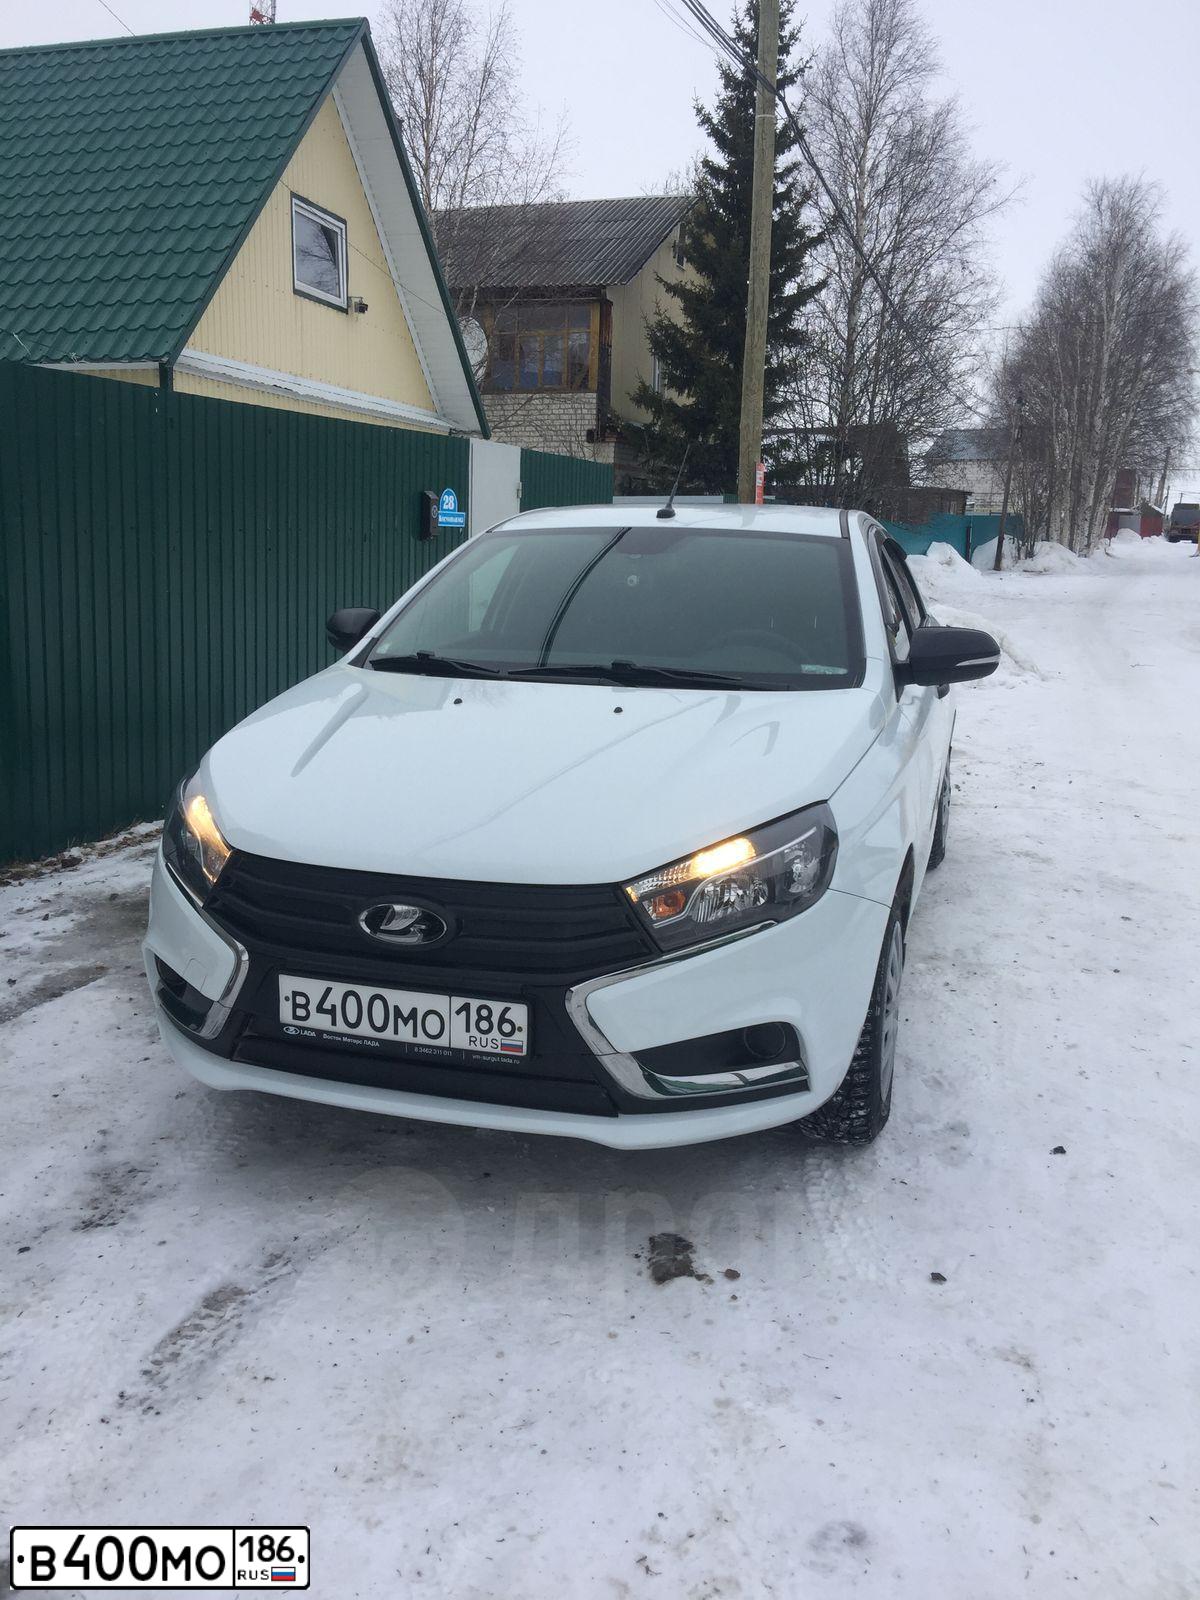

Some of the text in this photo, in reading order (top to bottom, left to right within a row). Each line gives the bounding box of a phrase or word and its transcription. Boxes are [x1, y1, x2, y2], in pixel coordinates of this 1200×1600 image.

[443, 495, 454, 510] 28
[291, 986, 516, 1040] В400МО 186
[300, 1029, 316, 1037] LADA
[468, 1035, 499, 1049] RUS
